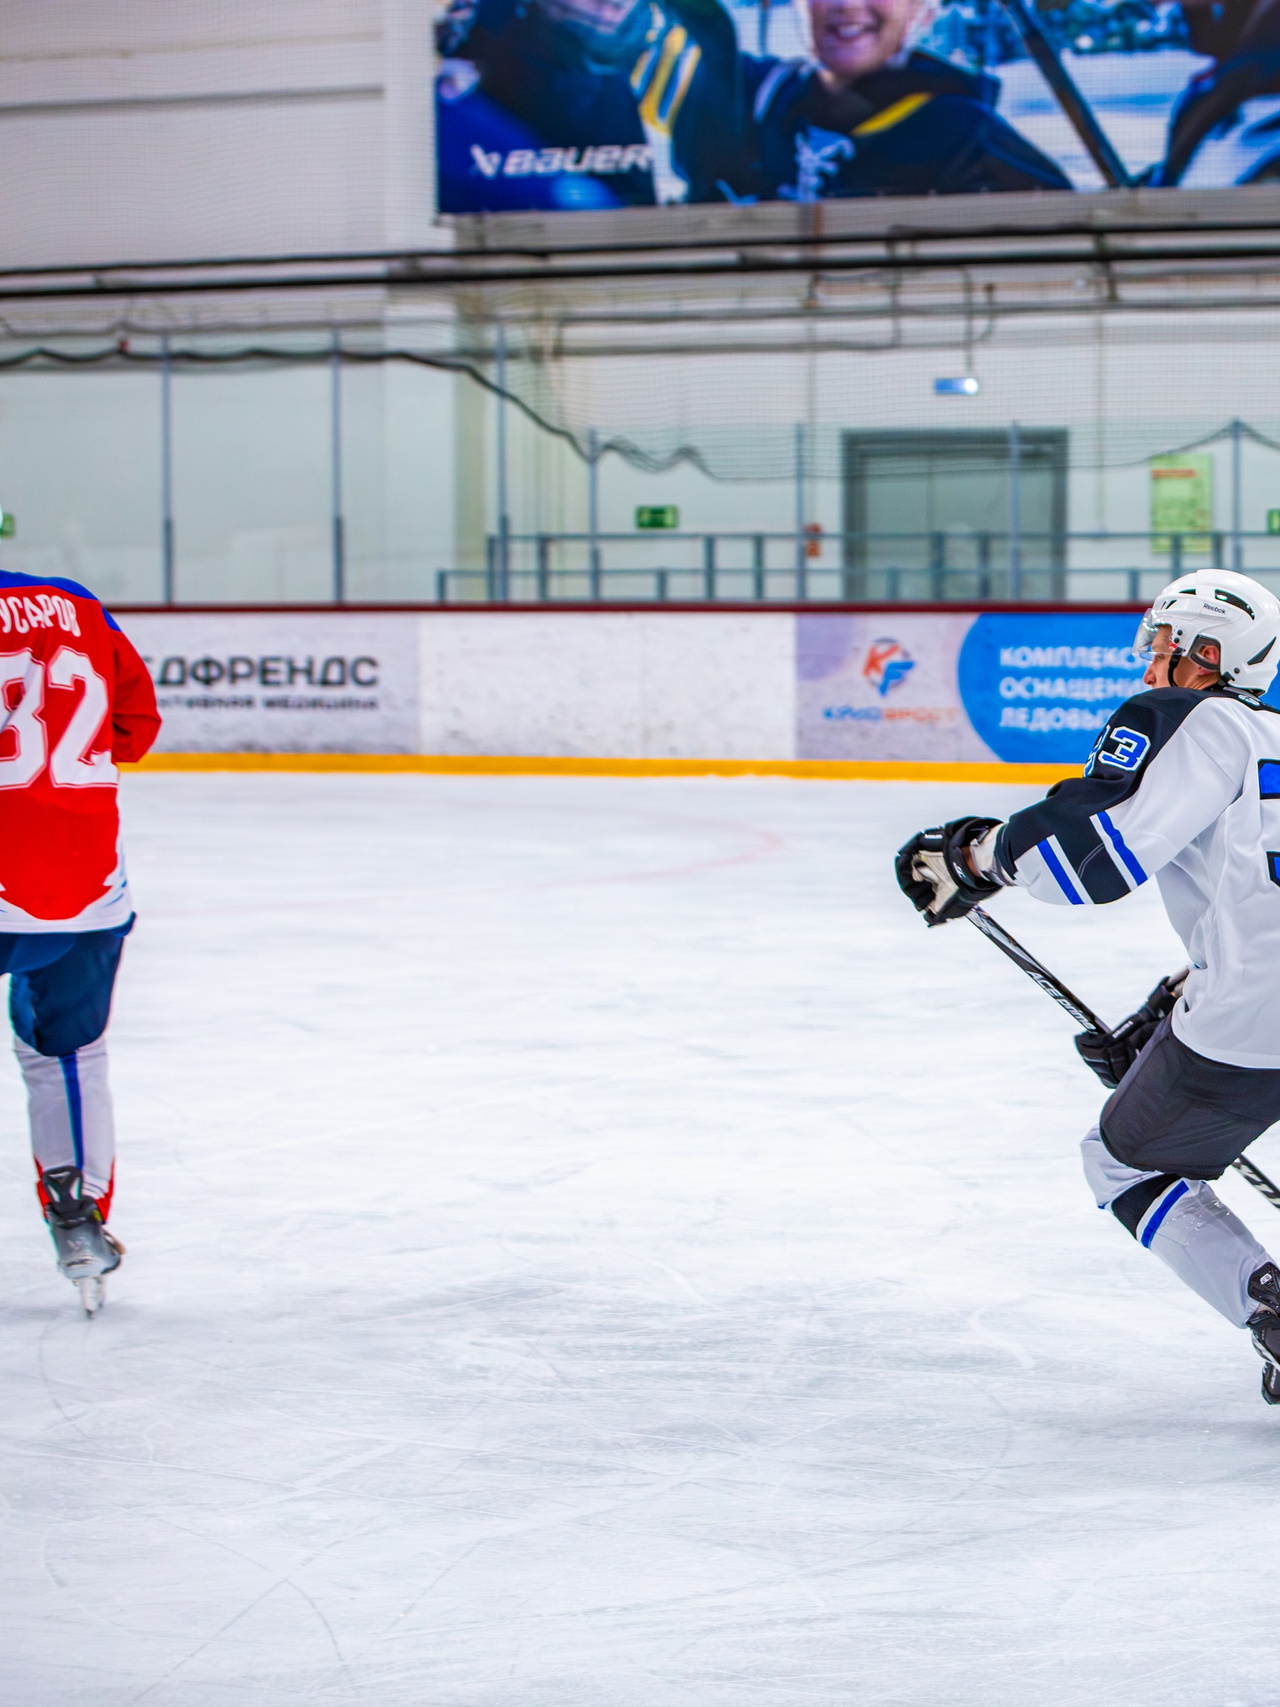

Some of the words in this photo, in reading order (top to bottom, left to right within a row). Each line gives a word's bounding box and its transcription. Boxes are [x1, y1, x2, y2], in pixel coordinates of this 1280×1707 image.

[503, 144, 652, 176] BAUER
[1000, 647, 1147, 669] КОМПЛЕКС
[999, 677, 1152, 701] ОСНАЩЕНИ
[999, 708, 1113, 732] ЛЕДОВЫ
[1025, 970, 1064, 1000] ACE
